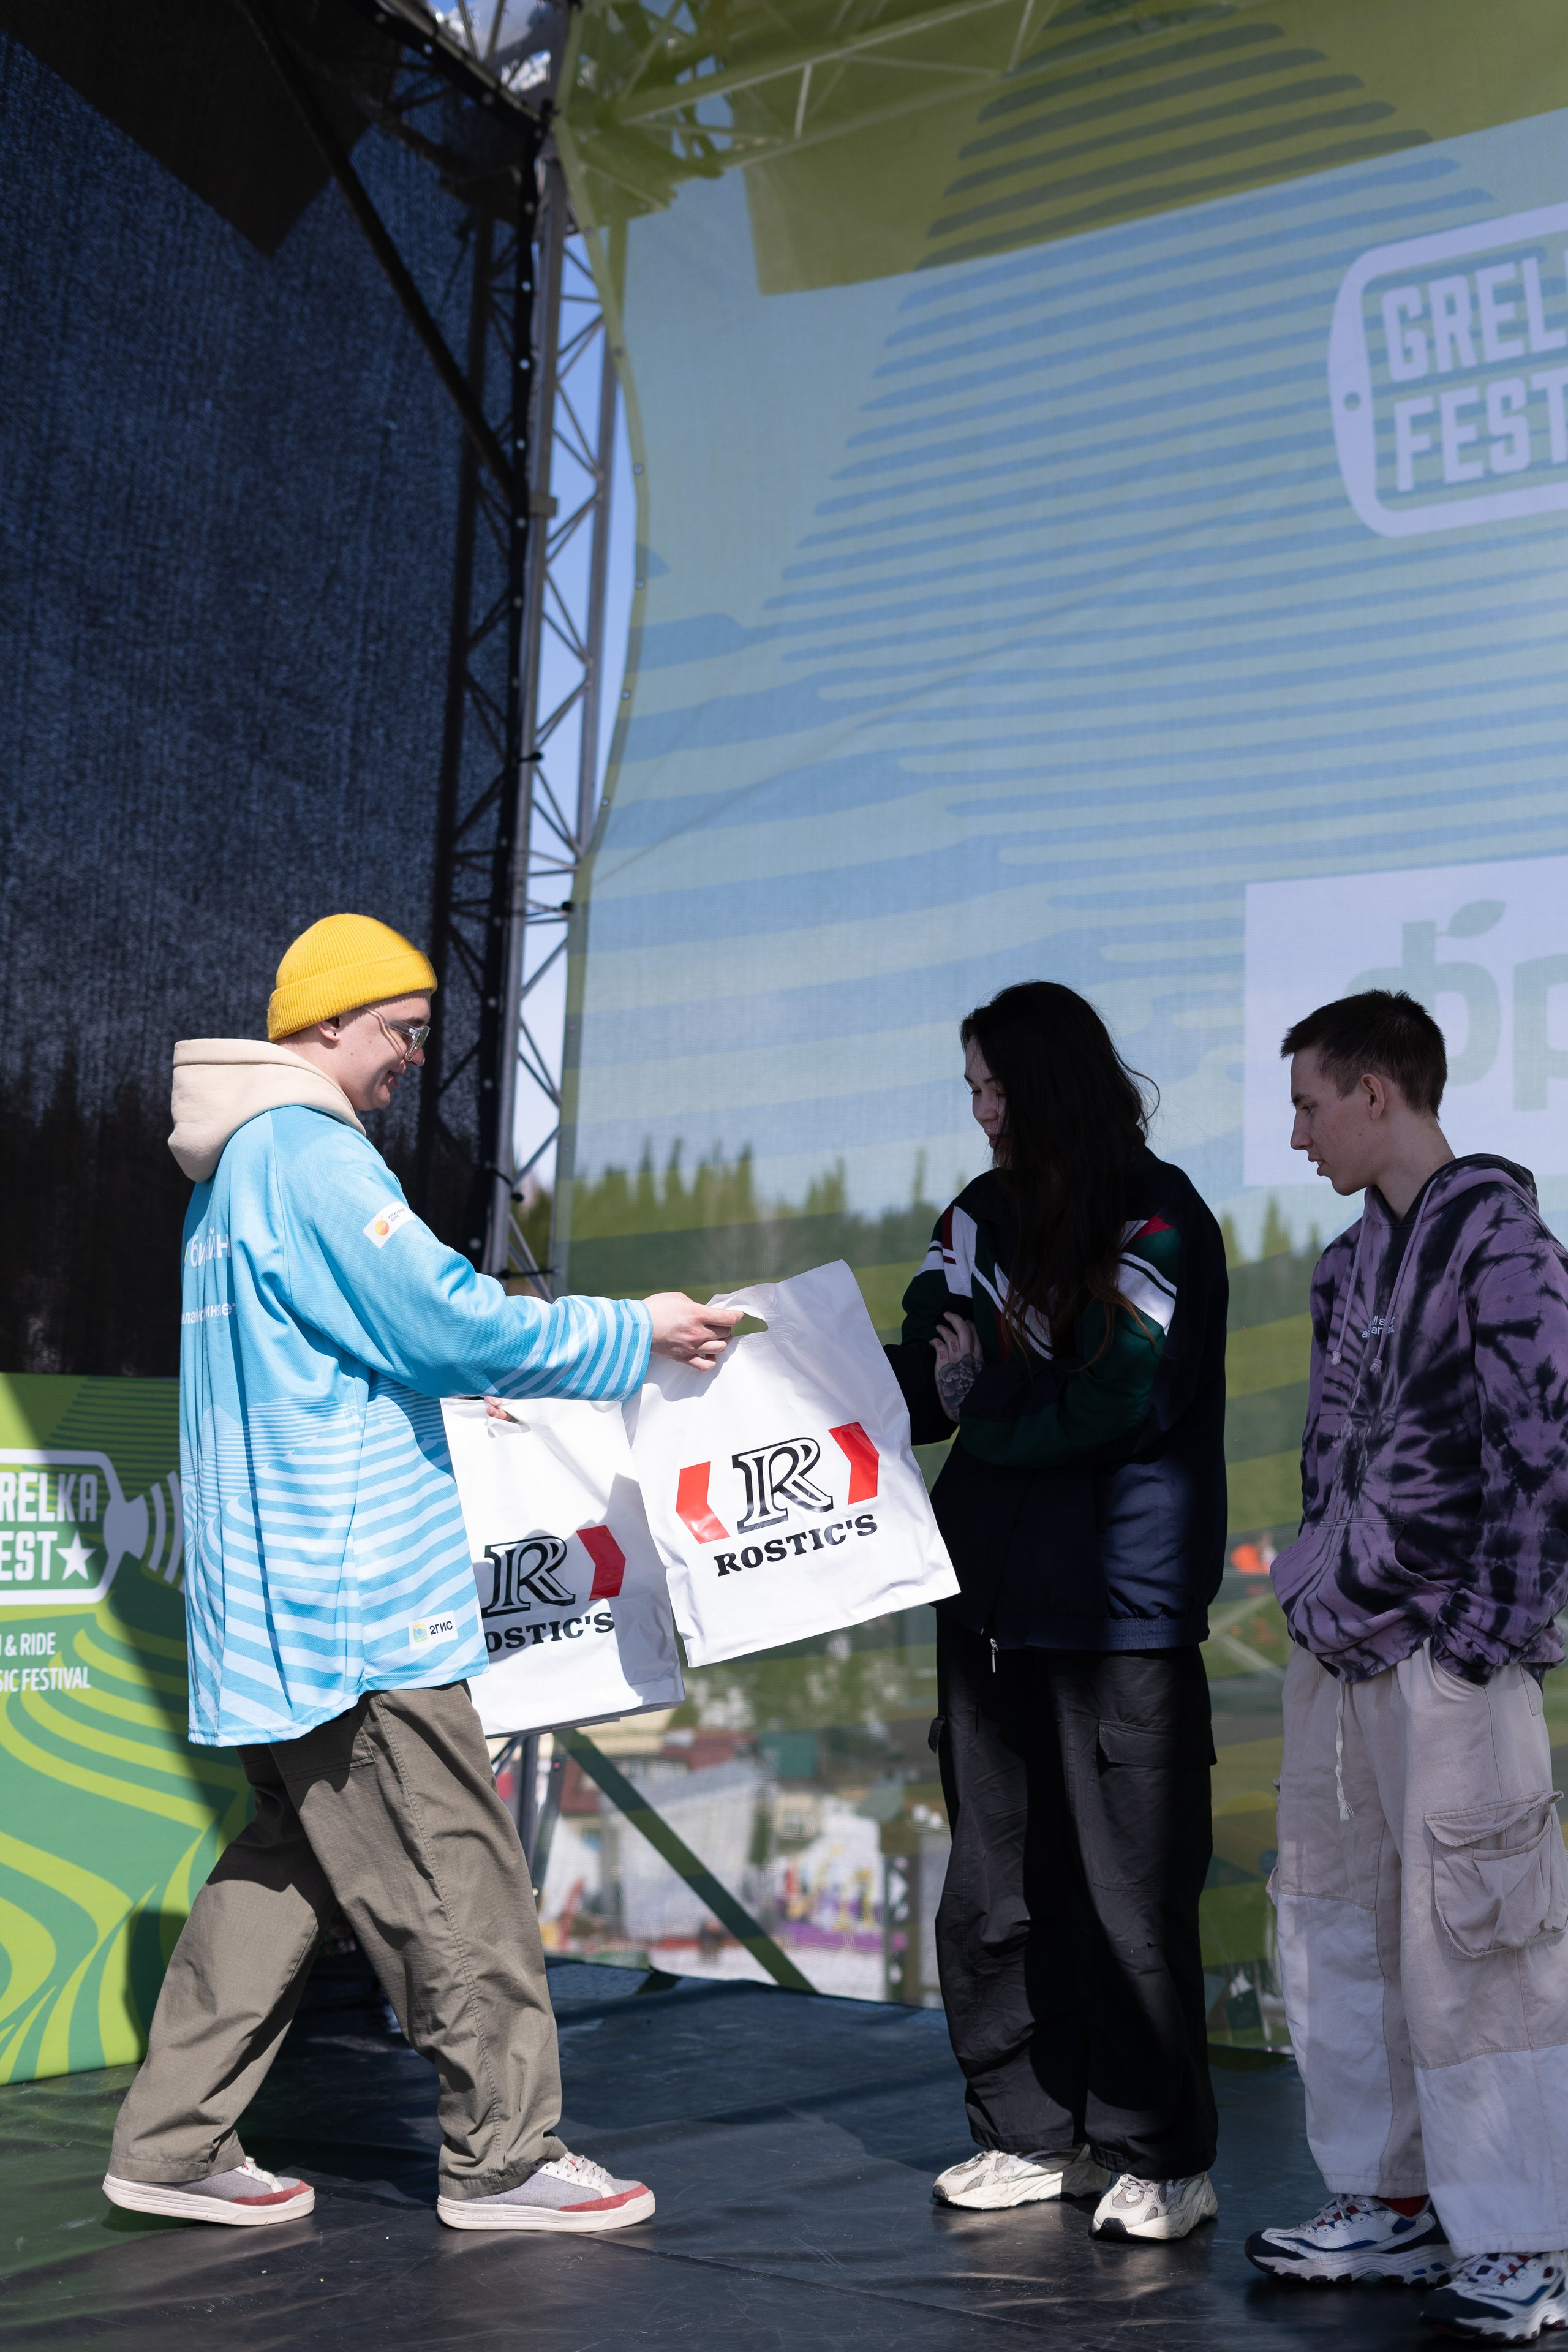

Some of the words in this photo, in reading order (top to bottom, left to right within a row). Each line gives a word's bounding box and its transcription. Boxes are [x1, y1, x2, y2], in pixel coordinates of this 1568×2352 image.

[1381, 249, 1568, 383] GREL
[1394, 367, 1568, 492] FEST
[731, 1437, 834, 1534] R
[481, 1535, 576, 1619] R
[713, 1513, 878, 1577] ROSTIC'S
[20, 1632, 57, 1656] RIDE
[429, 1621, 453, 1635] 2ГИС
[484, 1611, 616, 1653] OSTIC'S
[21, 1665, 91, 1692] FESTIVAL
